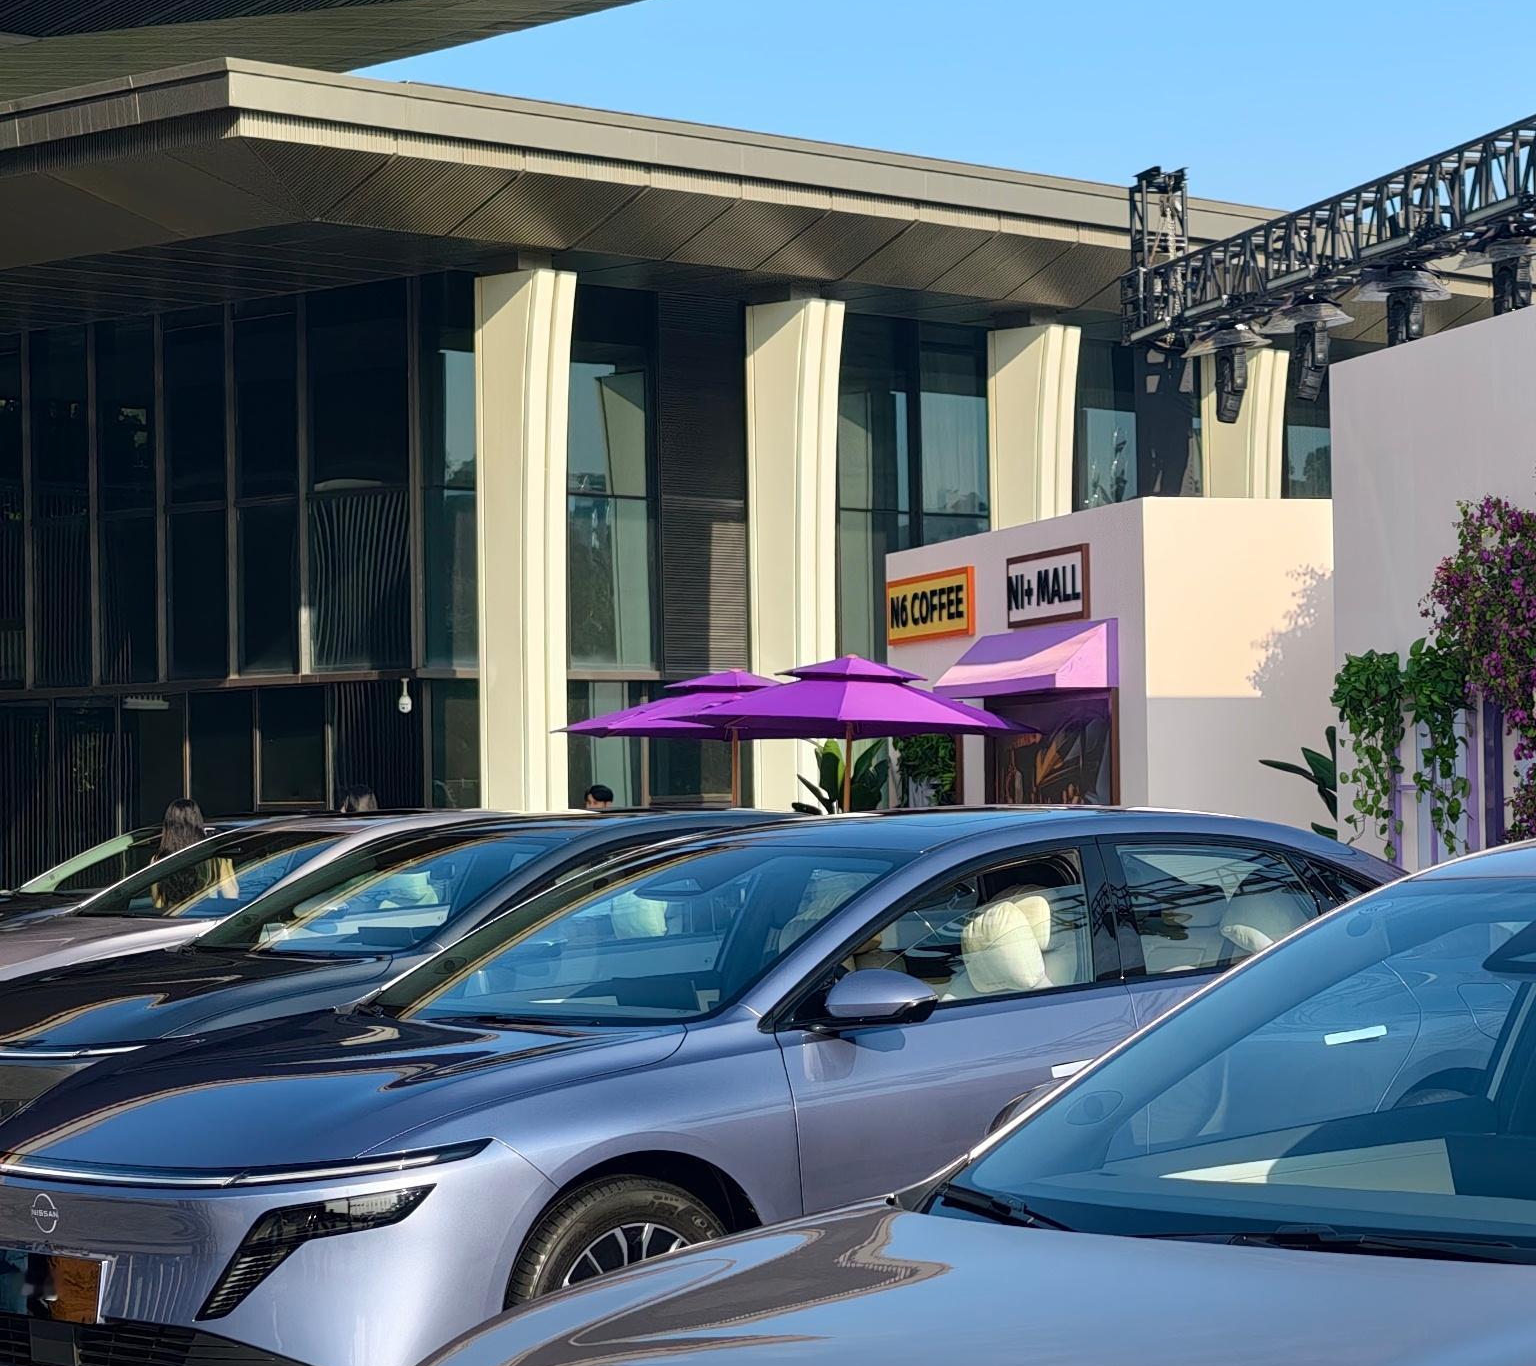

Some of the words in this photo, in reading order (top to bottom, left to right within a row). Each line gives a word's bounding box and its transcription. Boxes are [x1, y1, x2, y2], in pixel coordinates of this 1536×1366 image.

[890, 593, 909, 630] N6
[910, 583, 965, 627] COFFEE
[1036, 563, 1081, 607] MALL
[31, 1208, 59, 1218] NISSAN
